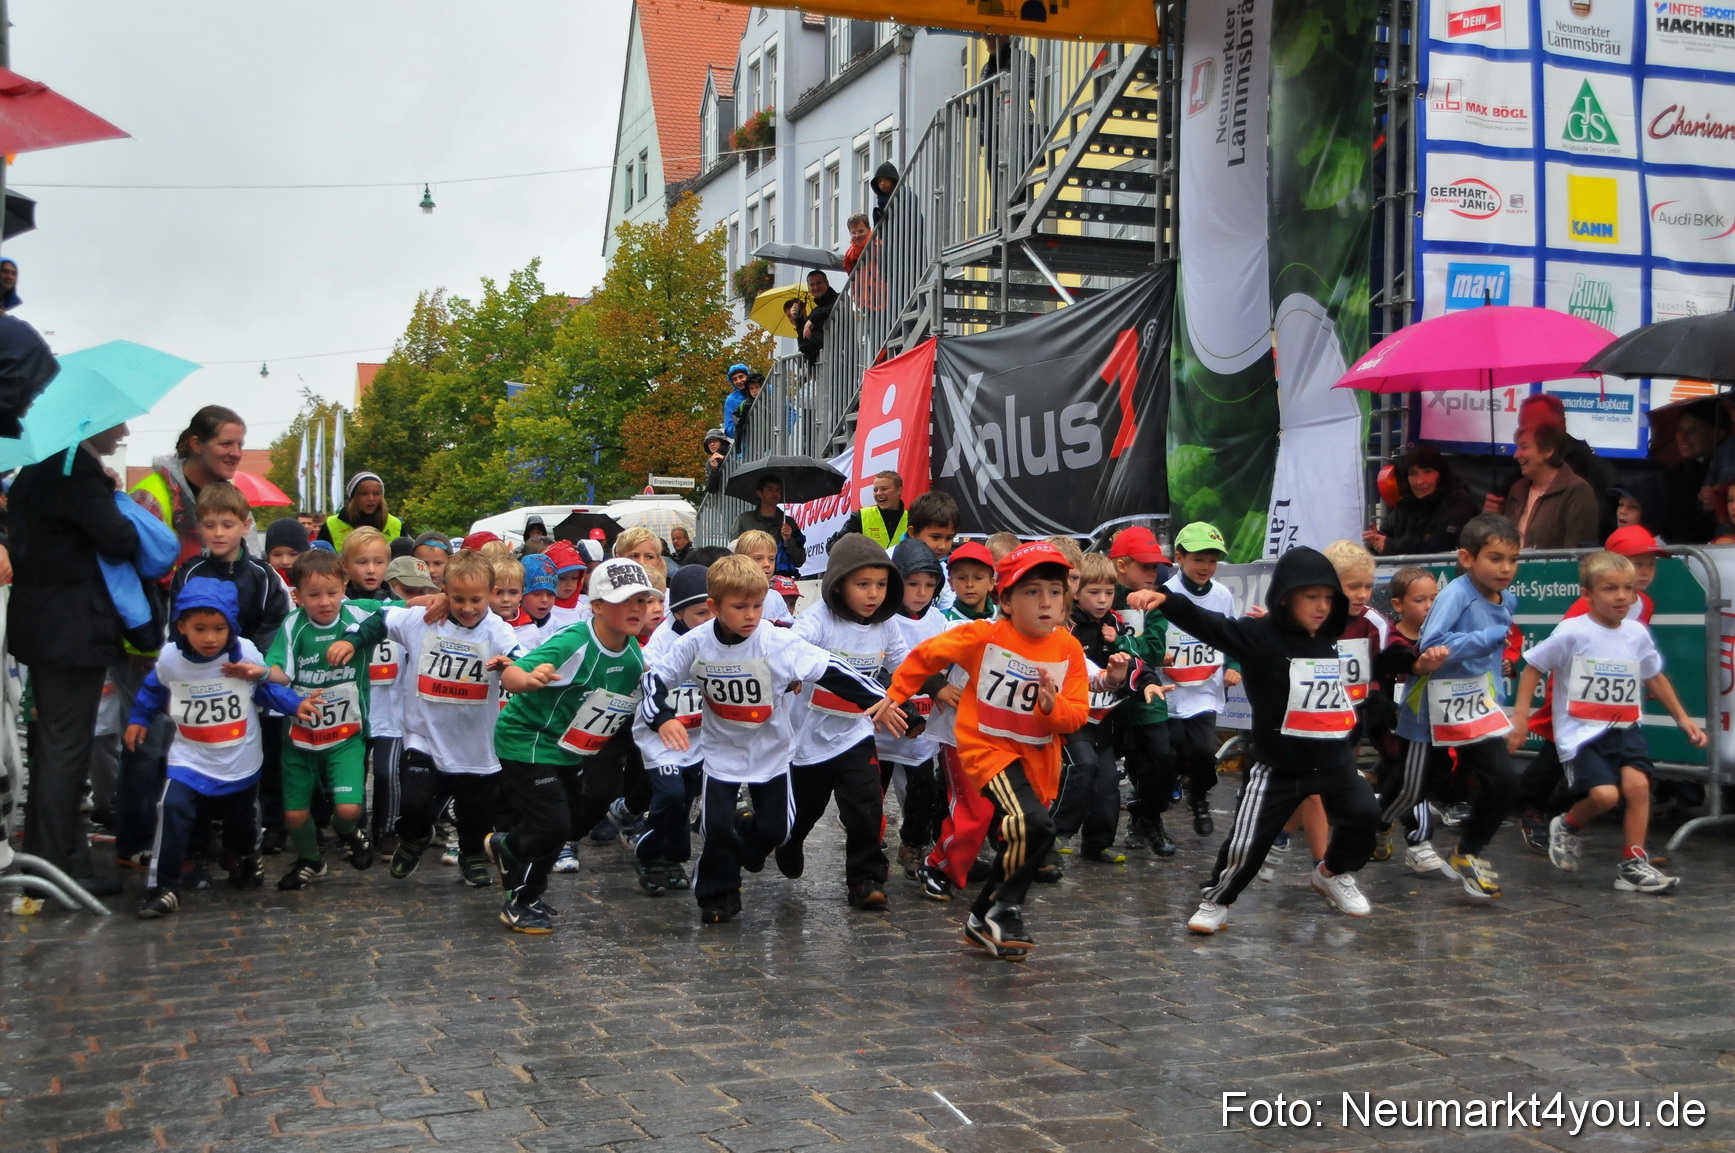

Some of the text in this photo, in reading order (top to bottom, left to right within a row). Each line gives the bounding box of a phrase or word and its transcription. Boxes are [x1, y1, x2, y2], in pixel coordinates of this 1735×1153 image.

[1462, 13, 1487, 29] DEHN
[1555, 20, 1611, 39] Neumarkter
[1656, 17, 1735, 39] HACKNER
[1547, 30, 1621, 56] Lammsbräu
[1216, 7, 1236, 145] Neumarkter
[1227, 0, 1254, 168] Lammsbrä
[1465, 102, 1528, 119] MAX BÖGL
[1430, 187, 1487, 200] GERHART
[1572, 220, 1613, 238] KANN
[1452, 272, 1505, 299] maxi
[653, 477, 694, 486] Brunnwirtsgasse
[1509, 579, 1581, 601] eit-System
[440, 641, 471, 651] BOCK
[1168, 644, 1216, 666] 7163
[298, 666, 356, 684] Münch
[427, 651, 484, 682] 7074
[706, 665, 741, 674] BOCK
[1008, 659, 1040, 676] BOC
[1594, 663, 1627, 672] BOCK
[431, 682, 468, 697] Maxim
[696, 675, 762, 704] 7309
[985, 669, 1050, 712] 719
[1451, 681, 1478, 692] BOCK
[1580, 675, 1636, 703] 7352
[180, 694, 242, 725] 7258
[299, 700, 350, 728] 057
[1438, 692, 1490, 723] 7216
[583, 706, 630, 735] 713
